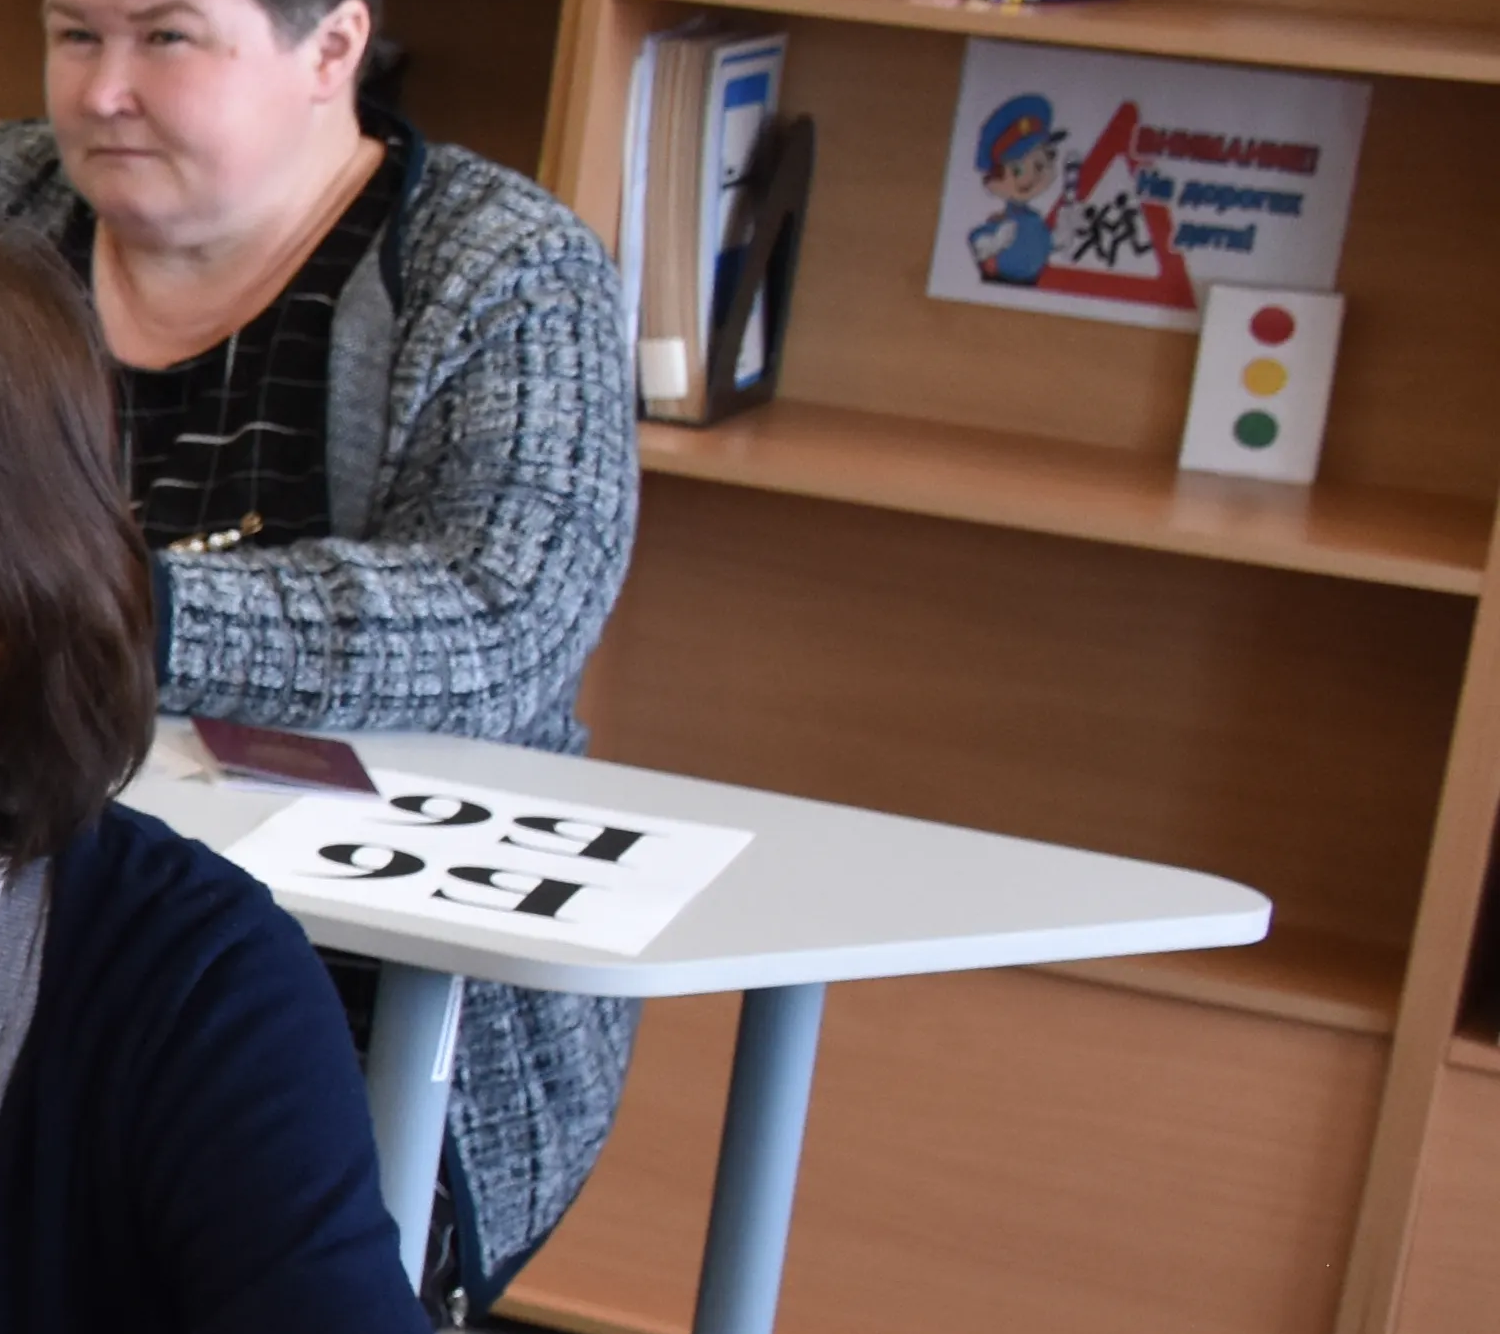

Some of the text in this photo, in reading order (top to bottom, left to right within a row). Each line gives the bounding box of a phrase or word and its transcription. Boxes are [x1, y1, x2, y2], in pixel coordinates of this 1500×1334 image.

[1136, 126, 1319, 177] ВНИМАНИЕ!
[1137, 169, 1304, 218] На дорогах
[1173, 221, 1257, 253] дети!
[372, 793, 665, 866] Б6
[297, 842, 604, 923] Б6
